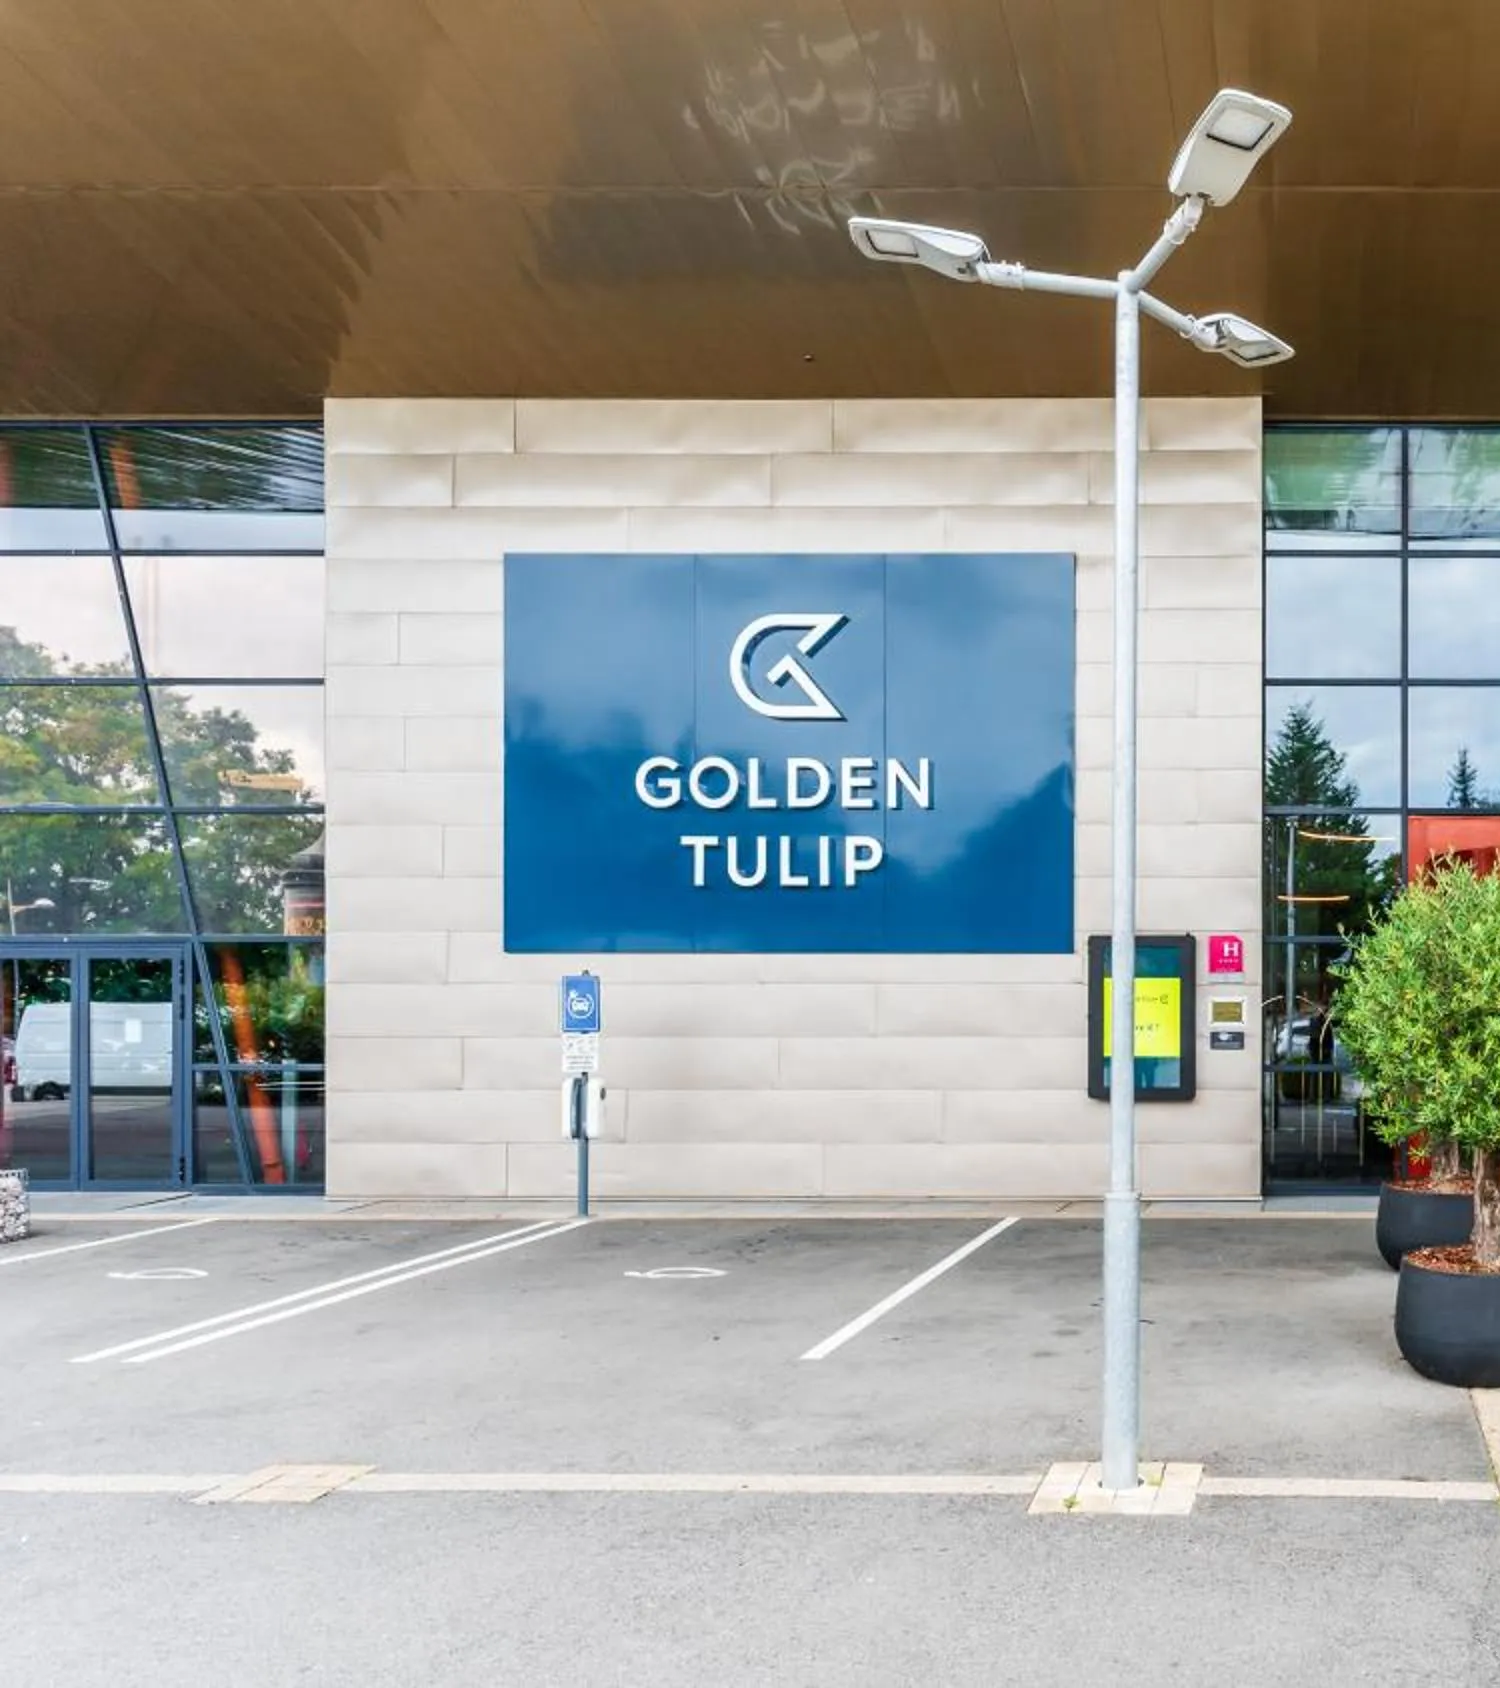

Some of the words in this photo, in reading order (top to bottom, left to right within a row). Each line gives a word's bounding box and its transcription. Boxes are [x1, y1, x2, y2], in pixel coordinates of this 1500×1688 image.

[635, 756, 931, 809] GOLDEN
[681, 836, 884, 887] TULIP
[1223, 942, 1239, 957] H
